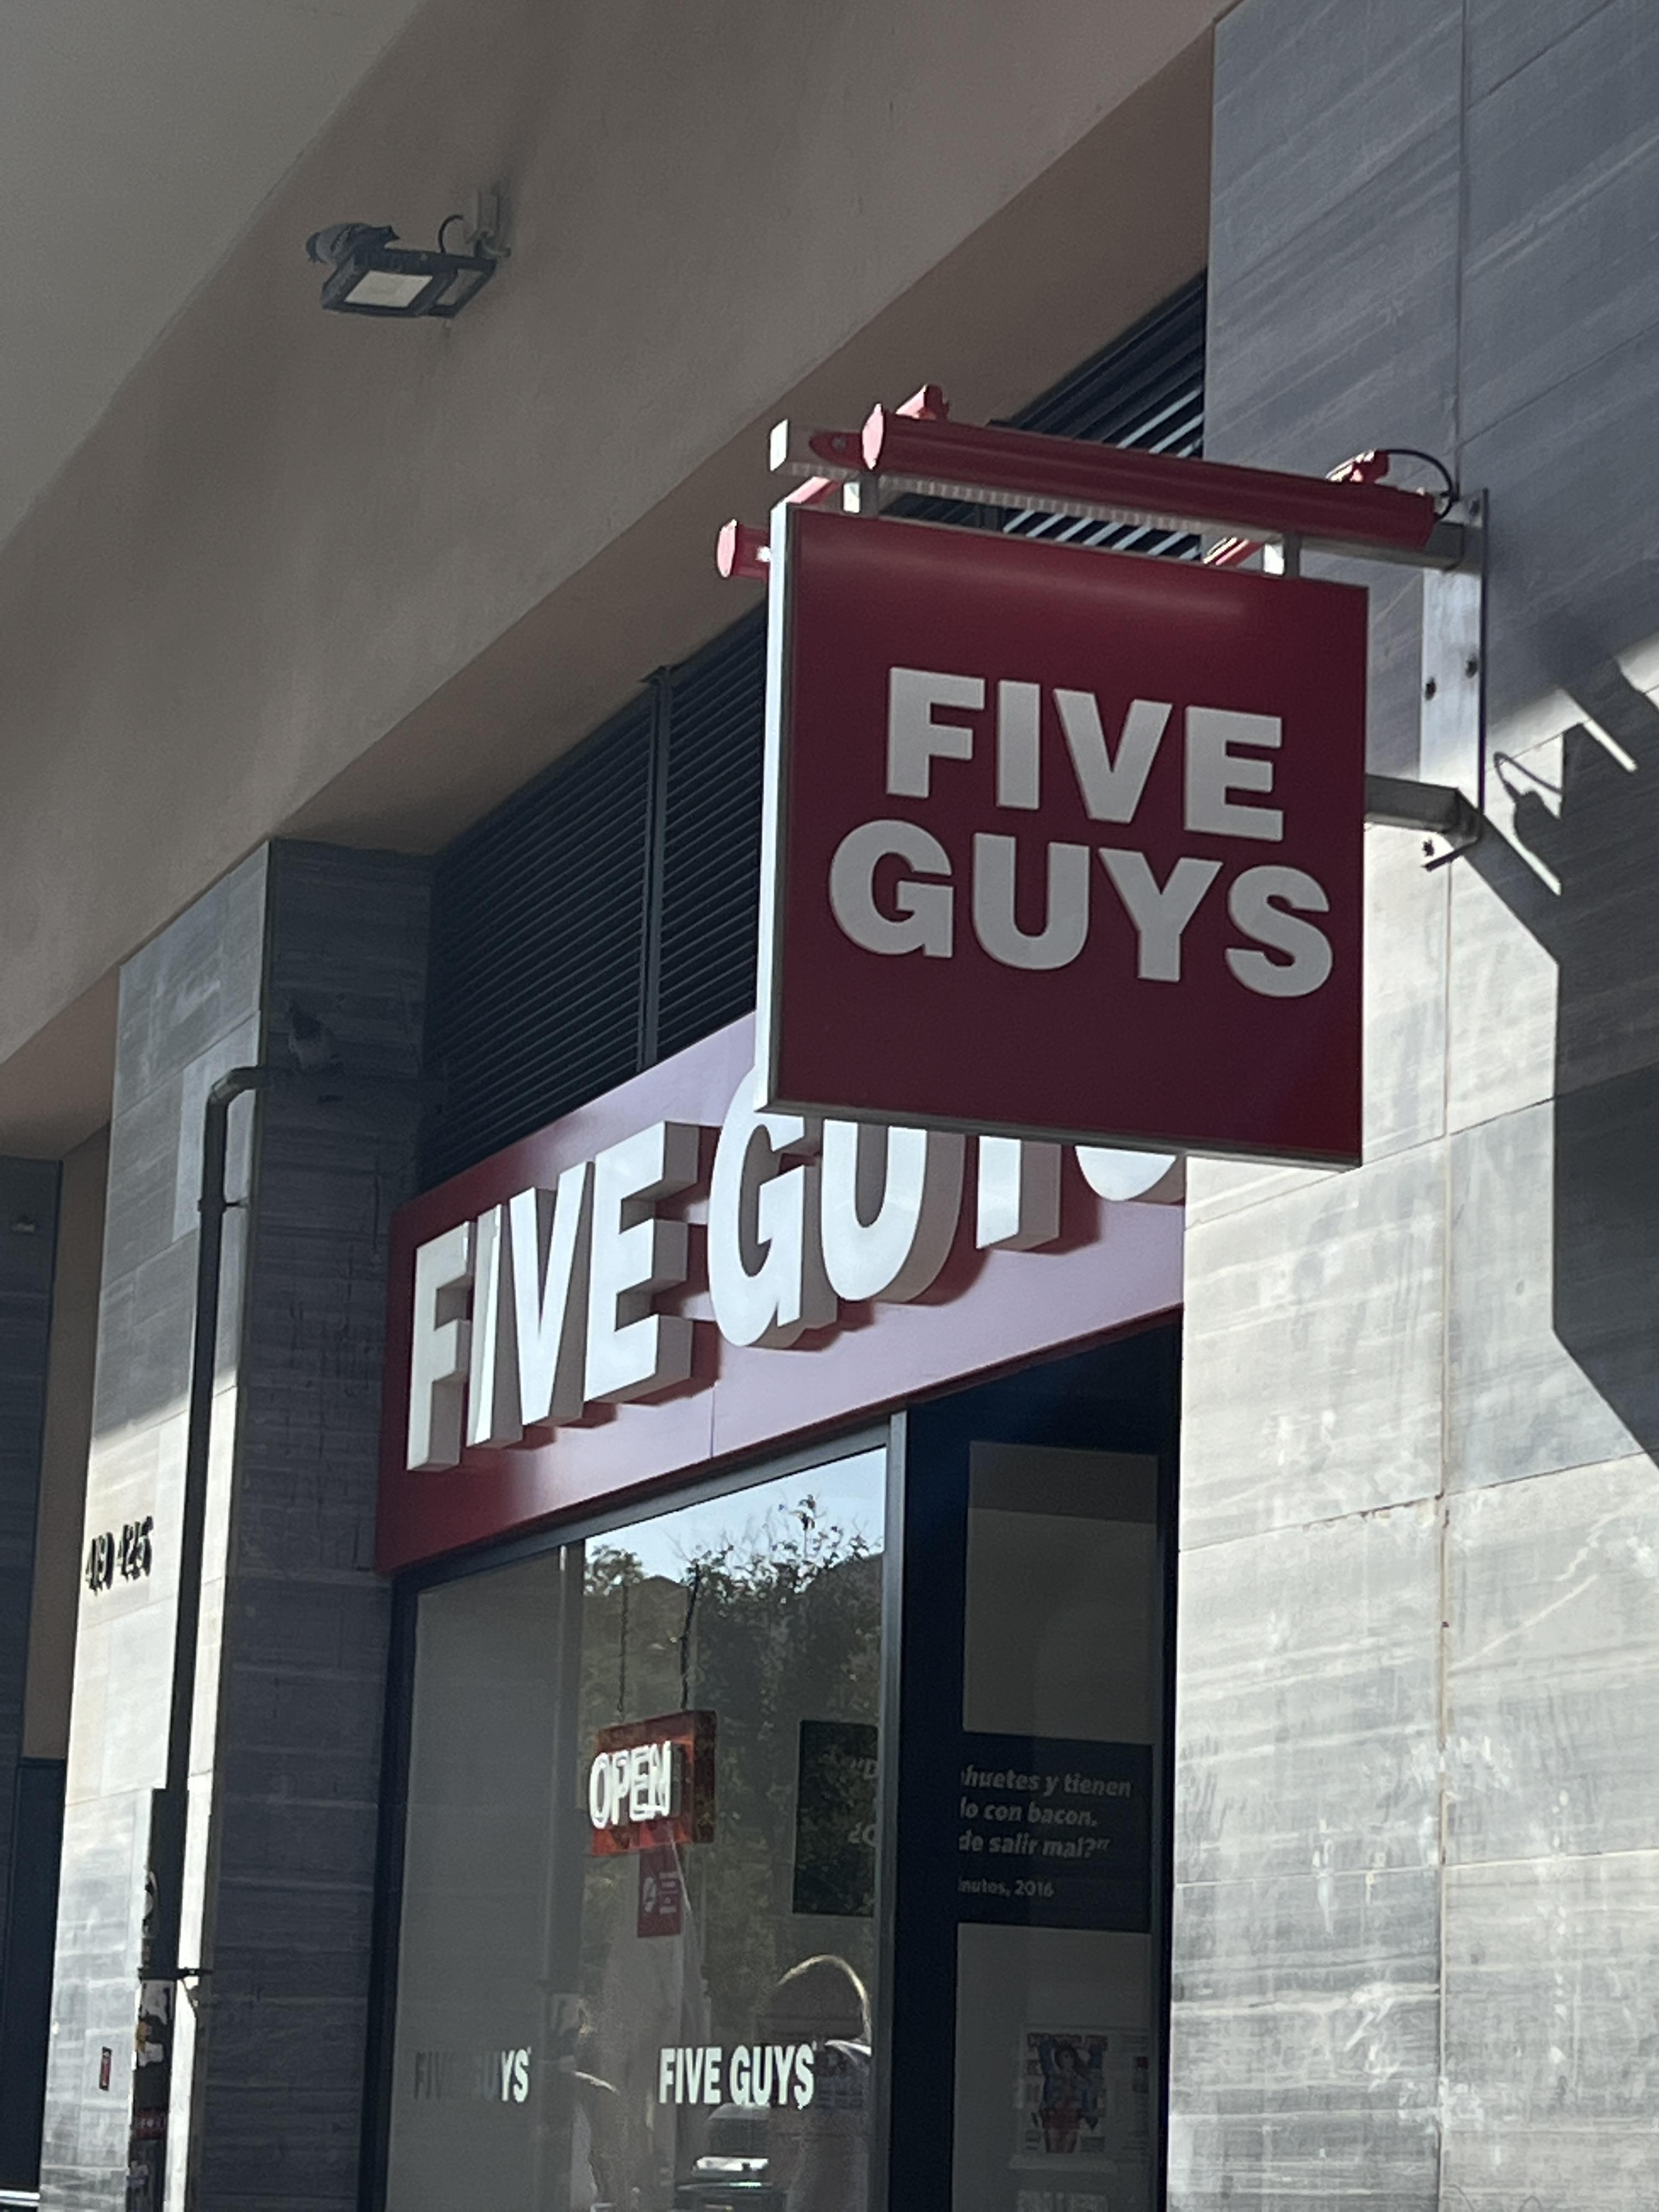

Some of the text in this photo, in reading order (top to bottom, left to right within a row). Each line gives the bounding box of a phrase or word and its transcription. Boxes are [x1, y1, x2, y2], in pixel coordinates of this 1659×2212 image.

[886, 667, 1283, 842] FIVE
[829, 819, 1334, 998] GUYS
[407, 1064, 1177, 1471] FIVE GU
[589, 1740, 672, 1830] OPEN
[984, 1804, 1022, 1821] con
[1027, 1801, 1098, 1827] bacon.
[1043, 1775, 1059, 1797] y
[1064, 1773, 1132, 1797] tienen
[958, 1829, 984, 1852] de
[989, 1832, 1039, 1857] salir
[1013, 1879, 1054, 1898] 2016
[659, 2044, 815, 2108] FIVE GUYS
